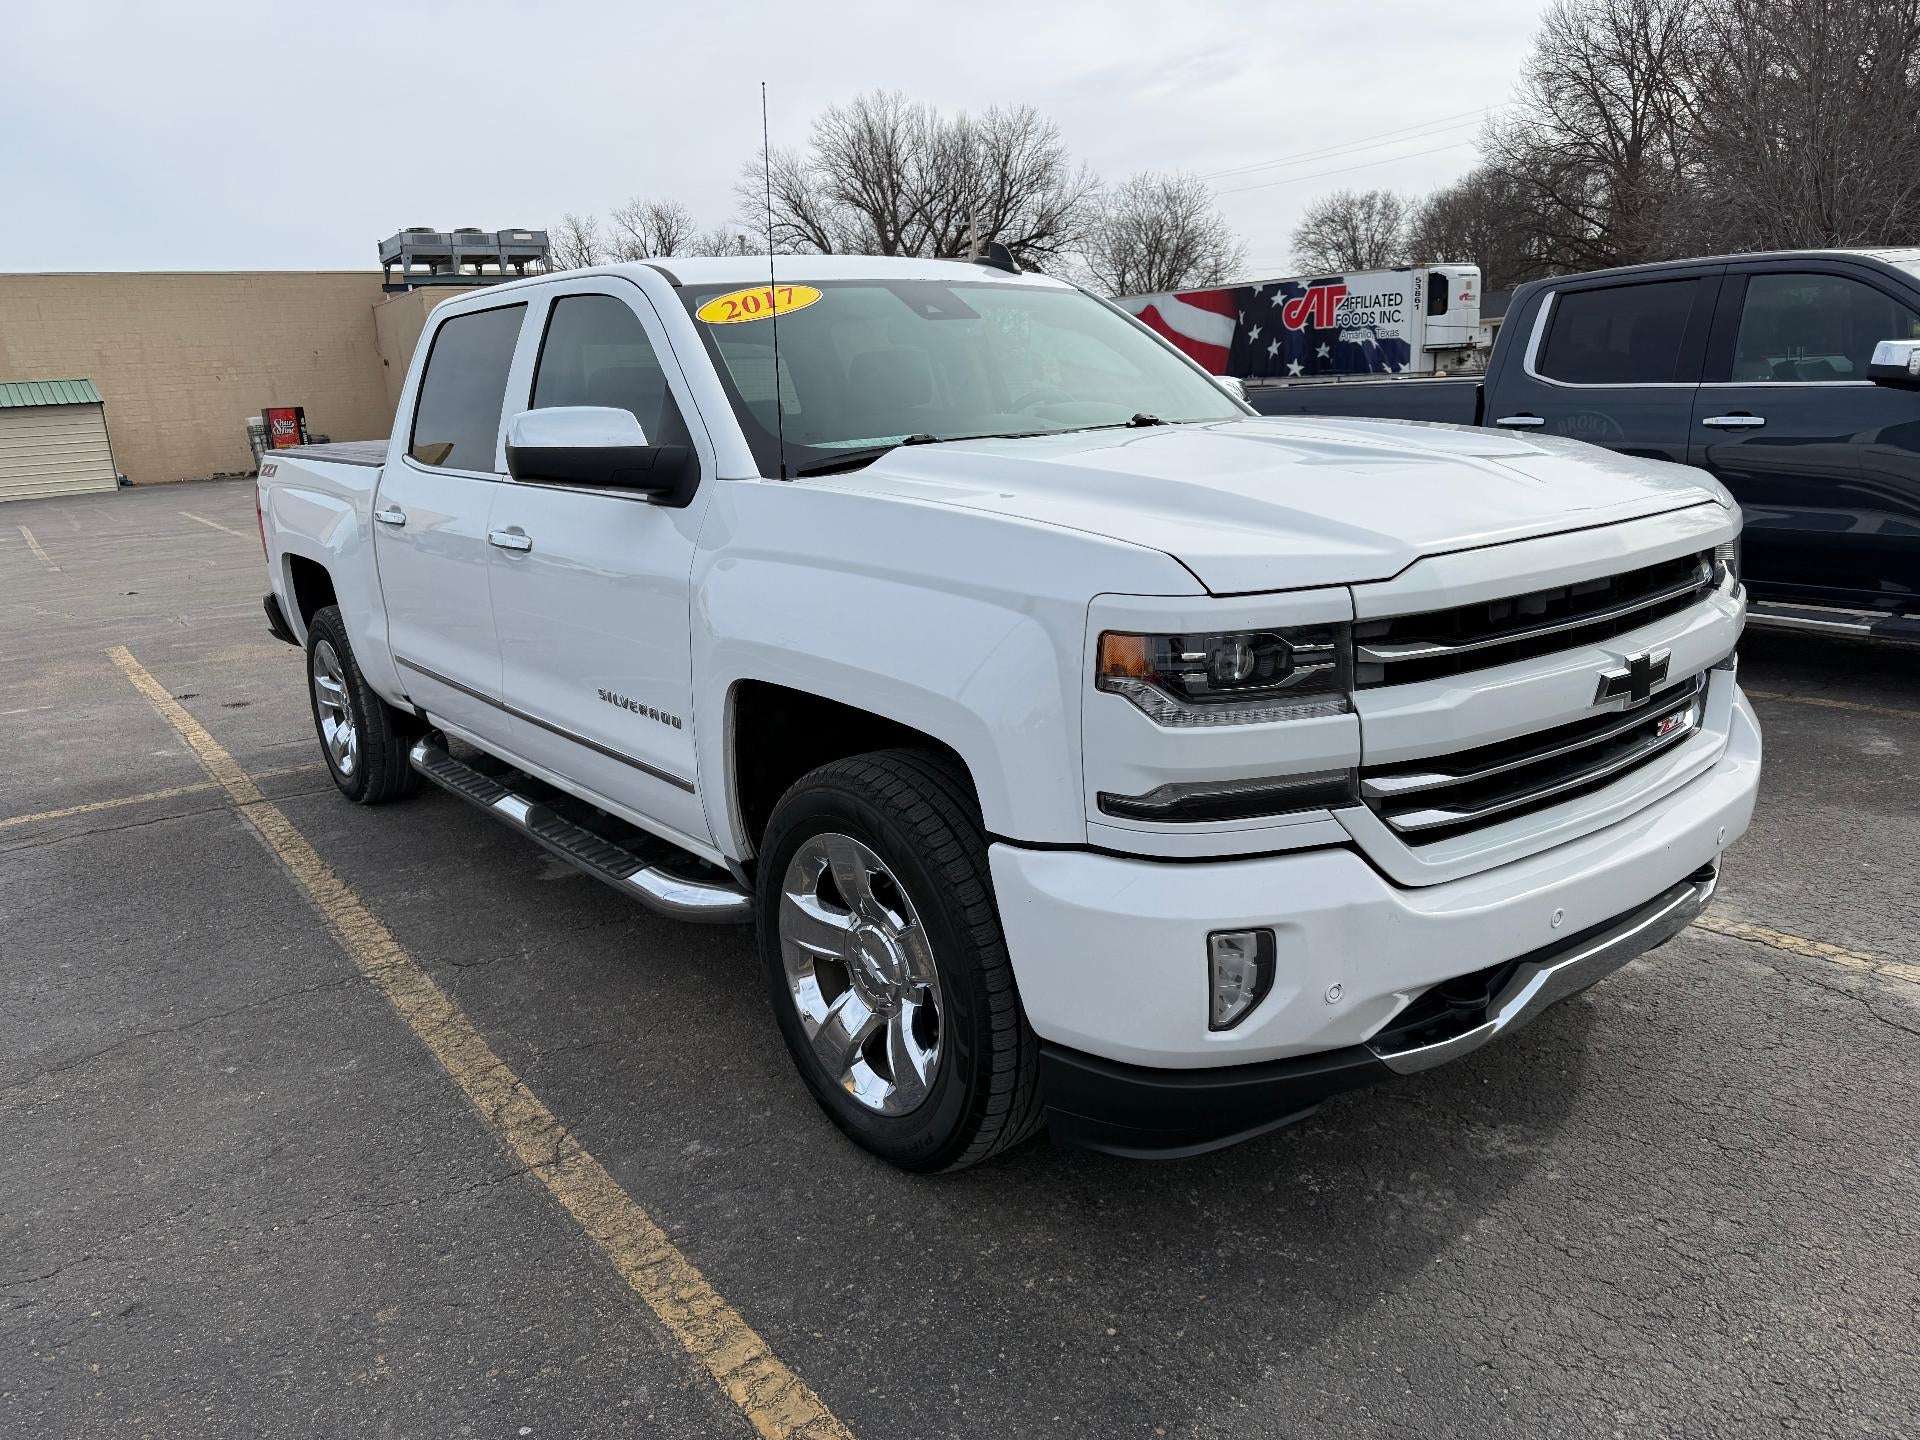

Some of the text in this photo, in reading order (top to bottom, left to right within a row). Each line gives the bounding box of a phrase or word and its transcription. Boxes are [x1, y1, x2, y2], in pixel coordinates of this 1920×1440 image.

[720, 287, 793, 320] 2017
[1337, 292, 1403, 311] AFFILIATED
[1335, 309, 1404, 327] FOODS INC.
[1376, 328, 1400, 338] Texas
[597, 688, 682, 730] SILVERADO
